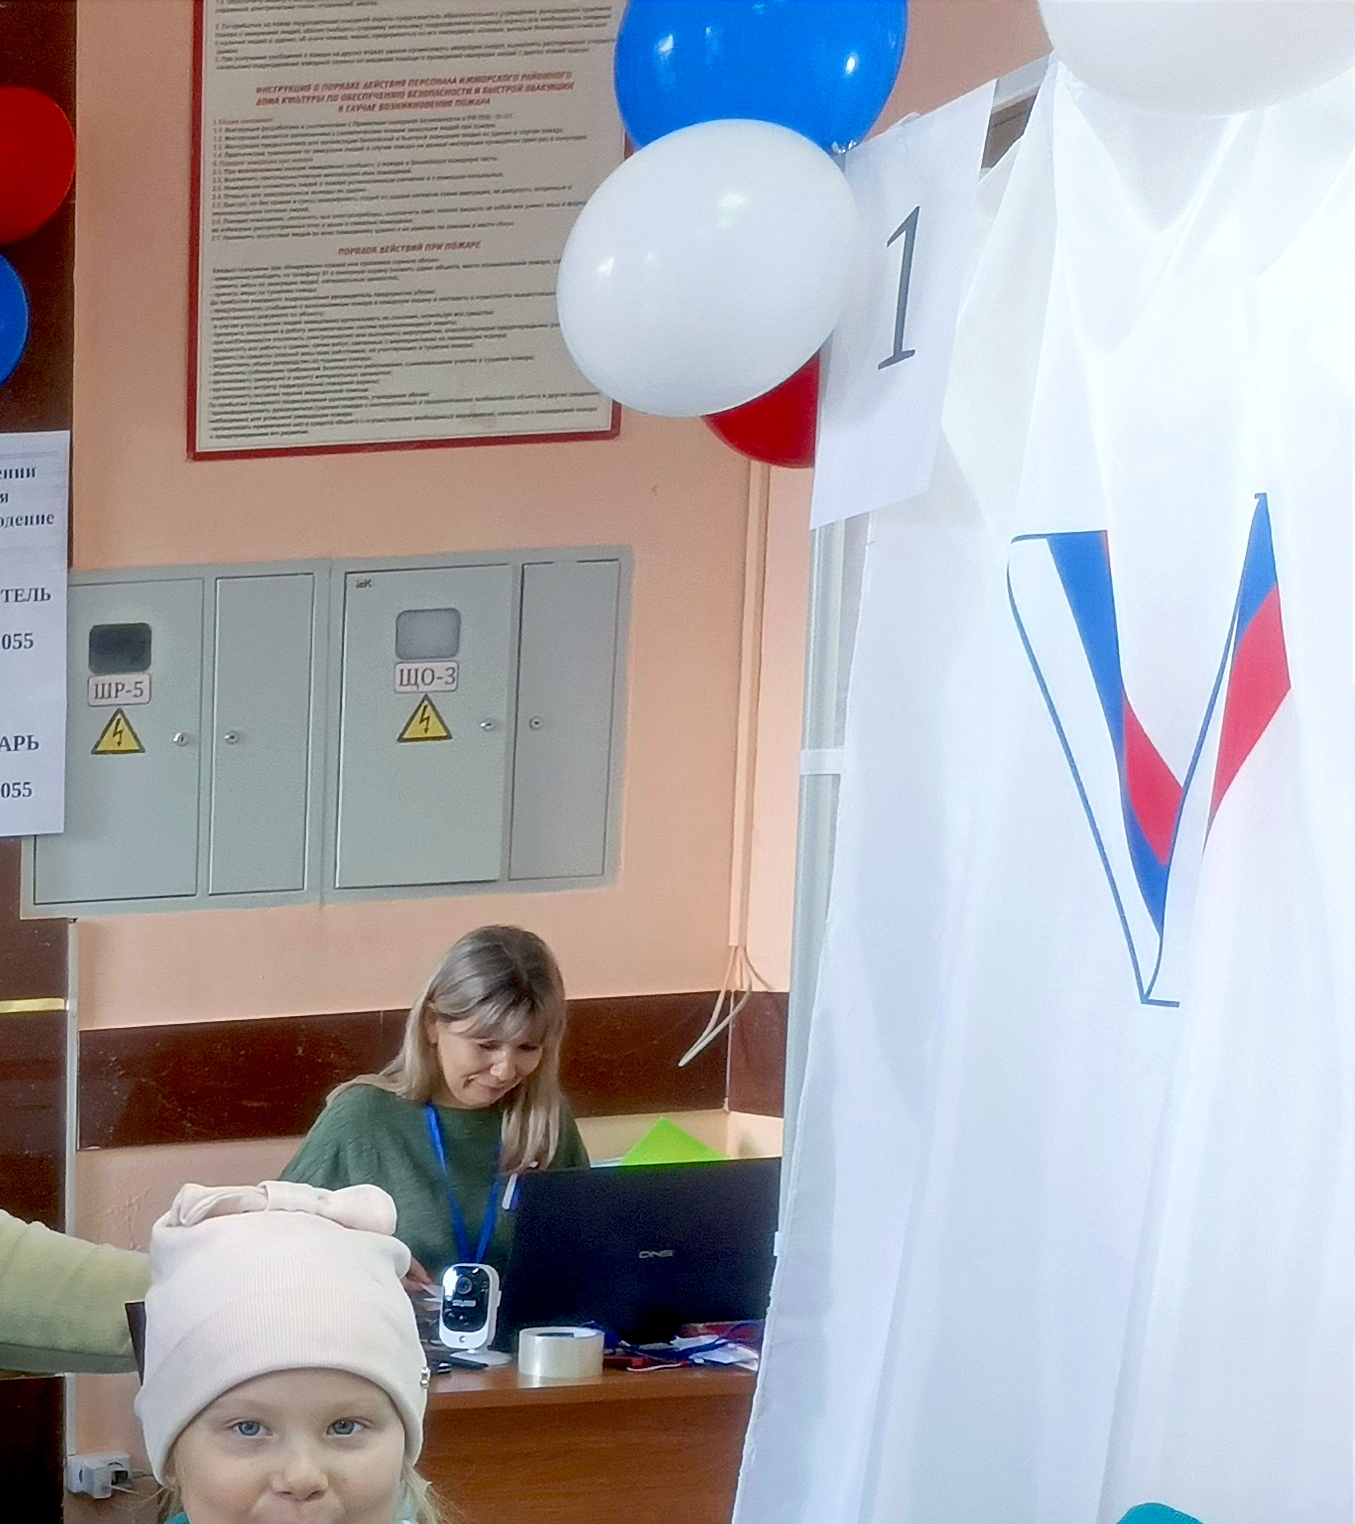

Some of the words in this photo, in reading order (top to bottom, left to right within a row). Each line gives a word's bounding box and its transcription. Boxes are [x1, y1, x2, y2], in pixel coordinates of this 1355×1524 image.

[878, 206, 920, 370] 1
[399, 668, 455, 688] ЩО-3
[93, 682, 145, 699] ШР-5
